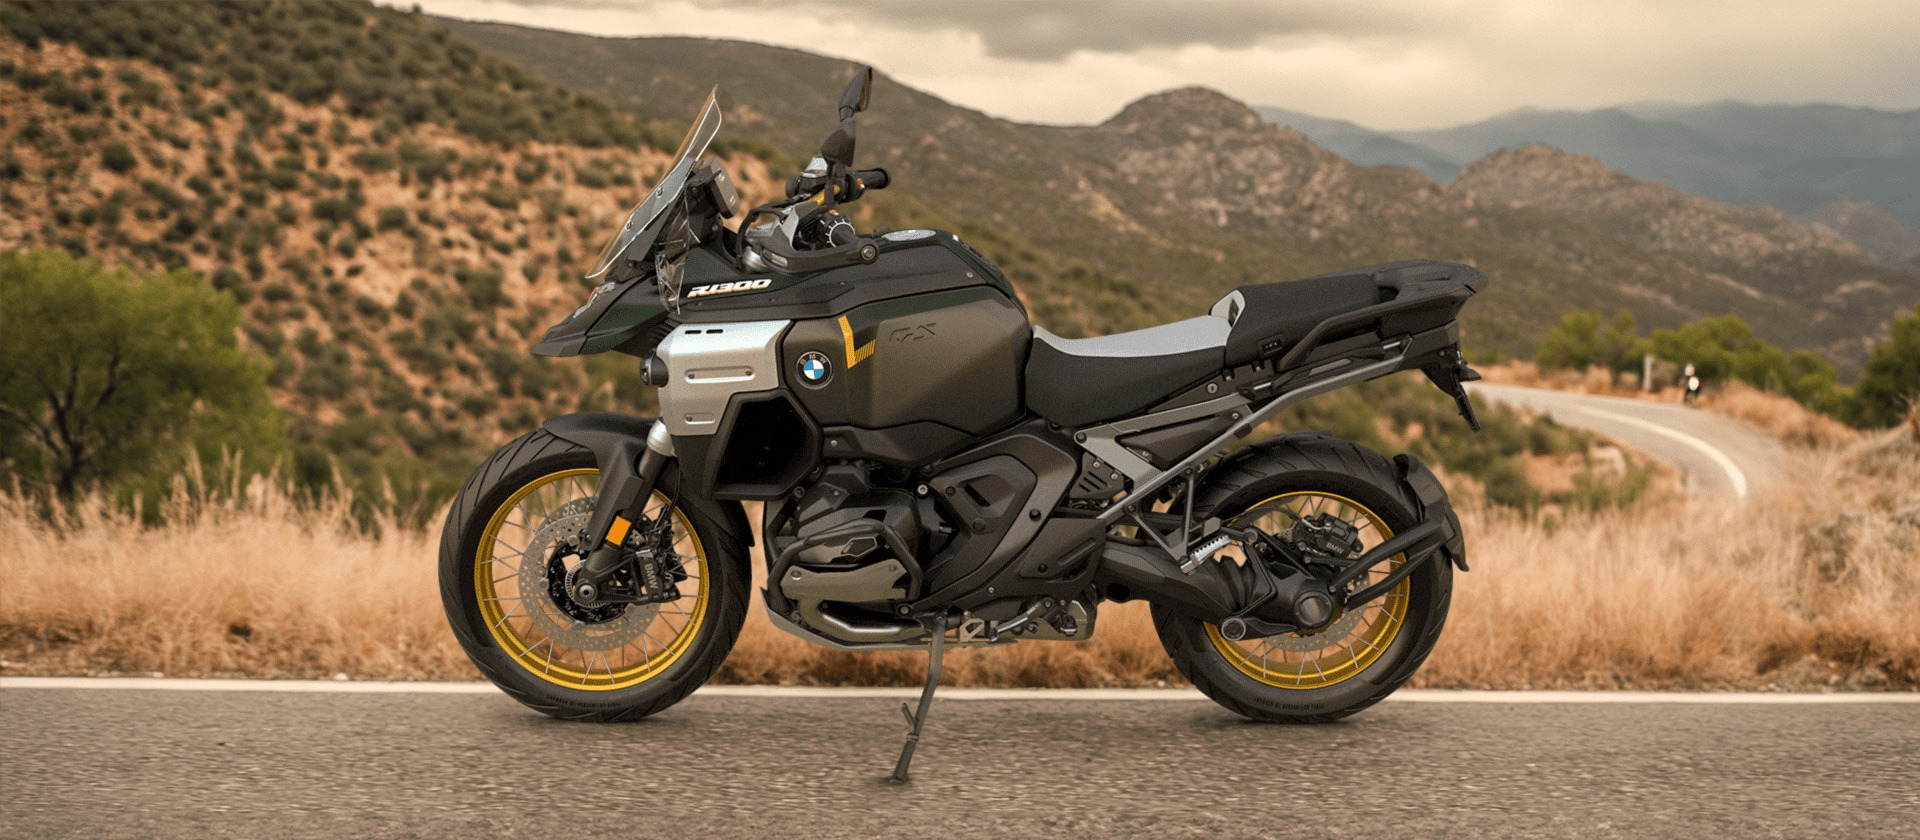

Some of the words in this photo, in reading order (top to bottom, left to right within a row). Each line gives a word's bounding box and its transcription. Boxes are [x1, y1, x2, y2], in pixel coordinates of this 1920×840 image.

[800, 353, 827, 366] BMW
[1325, 542, 1345, 554] BMW
[644, 563, 659, 589] BMW
